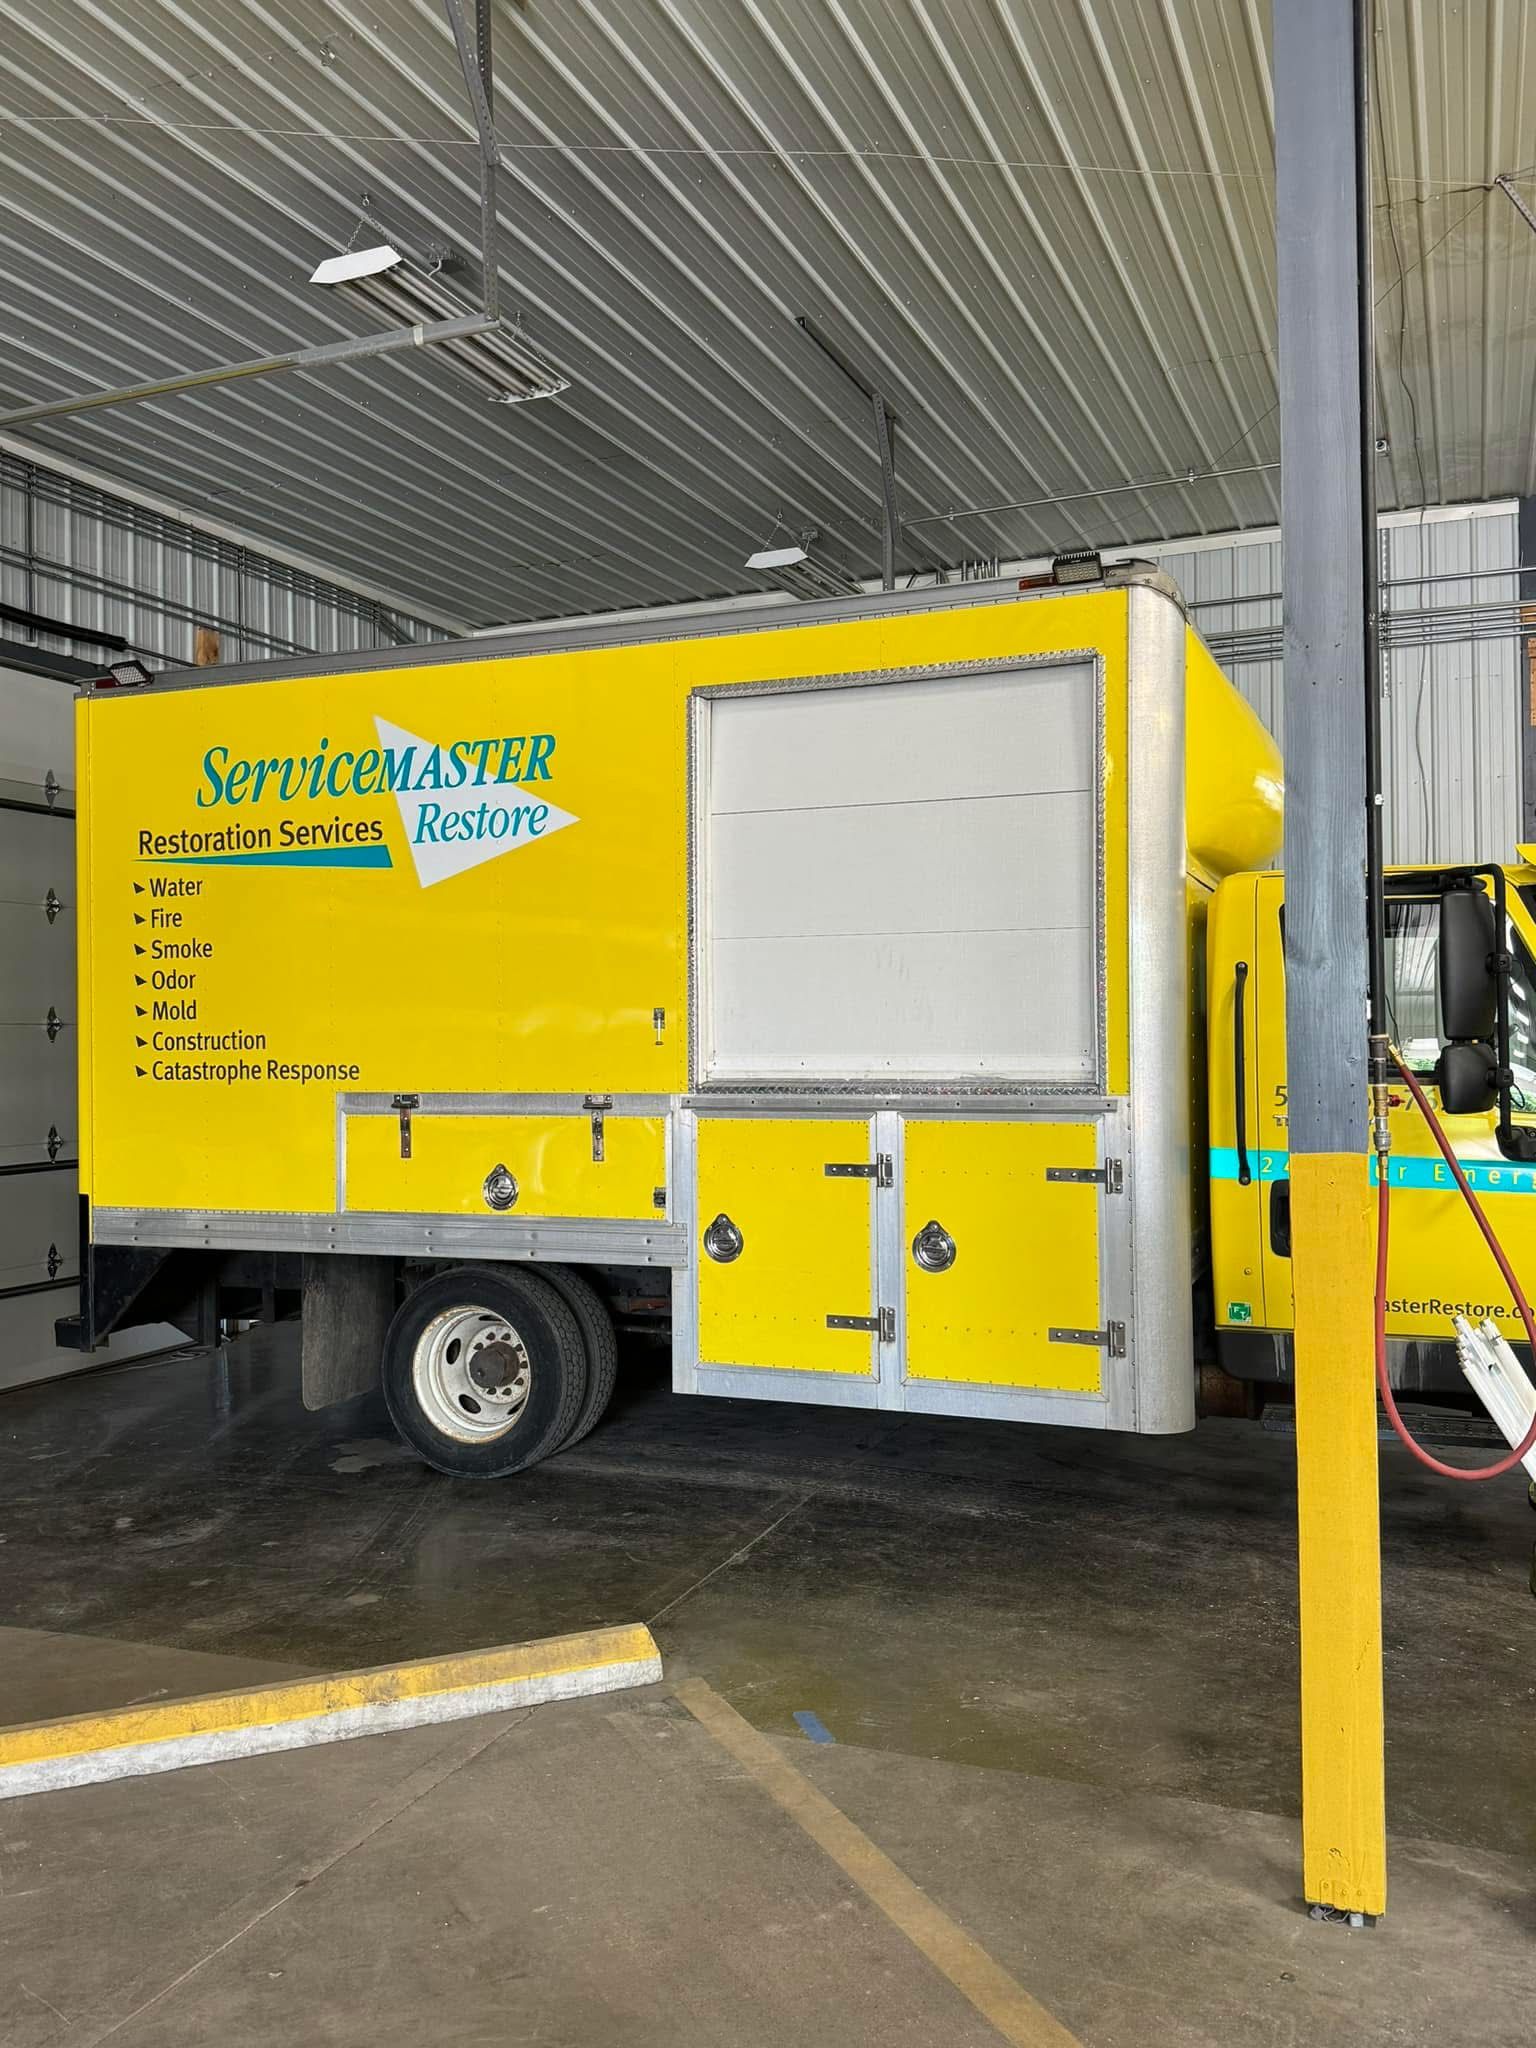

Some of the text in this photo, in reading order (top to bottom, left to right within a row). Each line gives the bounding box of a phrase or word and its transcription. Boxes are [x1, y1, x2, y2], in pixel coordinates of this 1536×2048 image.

[412, 801, 550, 845] Restore
[138, 816, 384, 857] Restoration Services
[149, 878, 203, 897] Water
[151, 908, 183, 928] Fire
[151, 938, 213, 959] Smoke
[152, 969, 197, 990] Odor
[152, 1000, 197, 1020] Mold
[152, 1029, 267, 1051] Construction
[152, 1059, 361, 1085] Catastrophe Response
